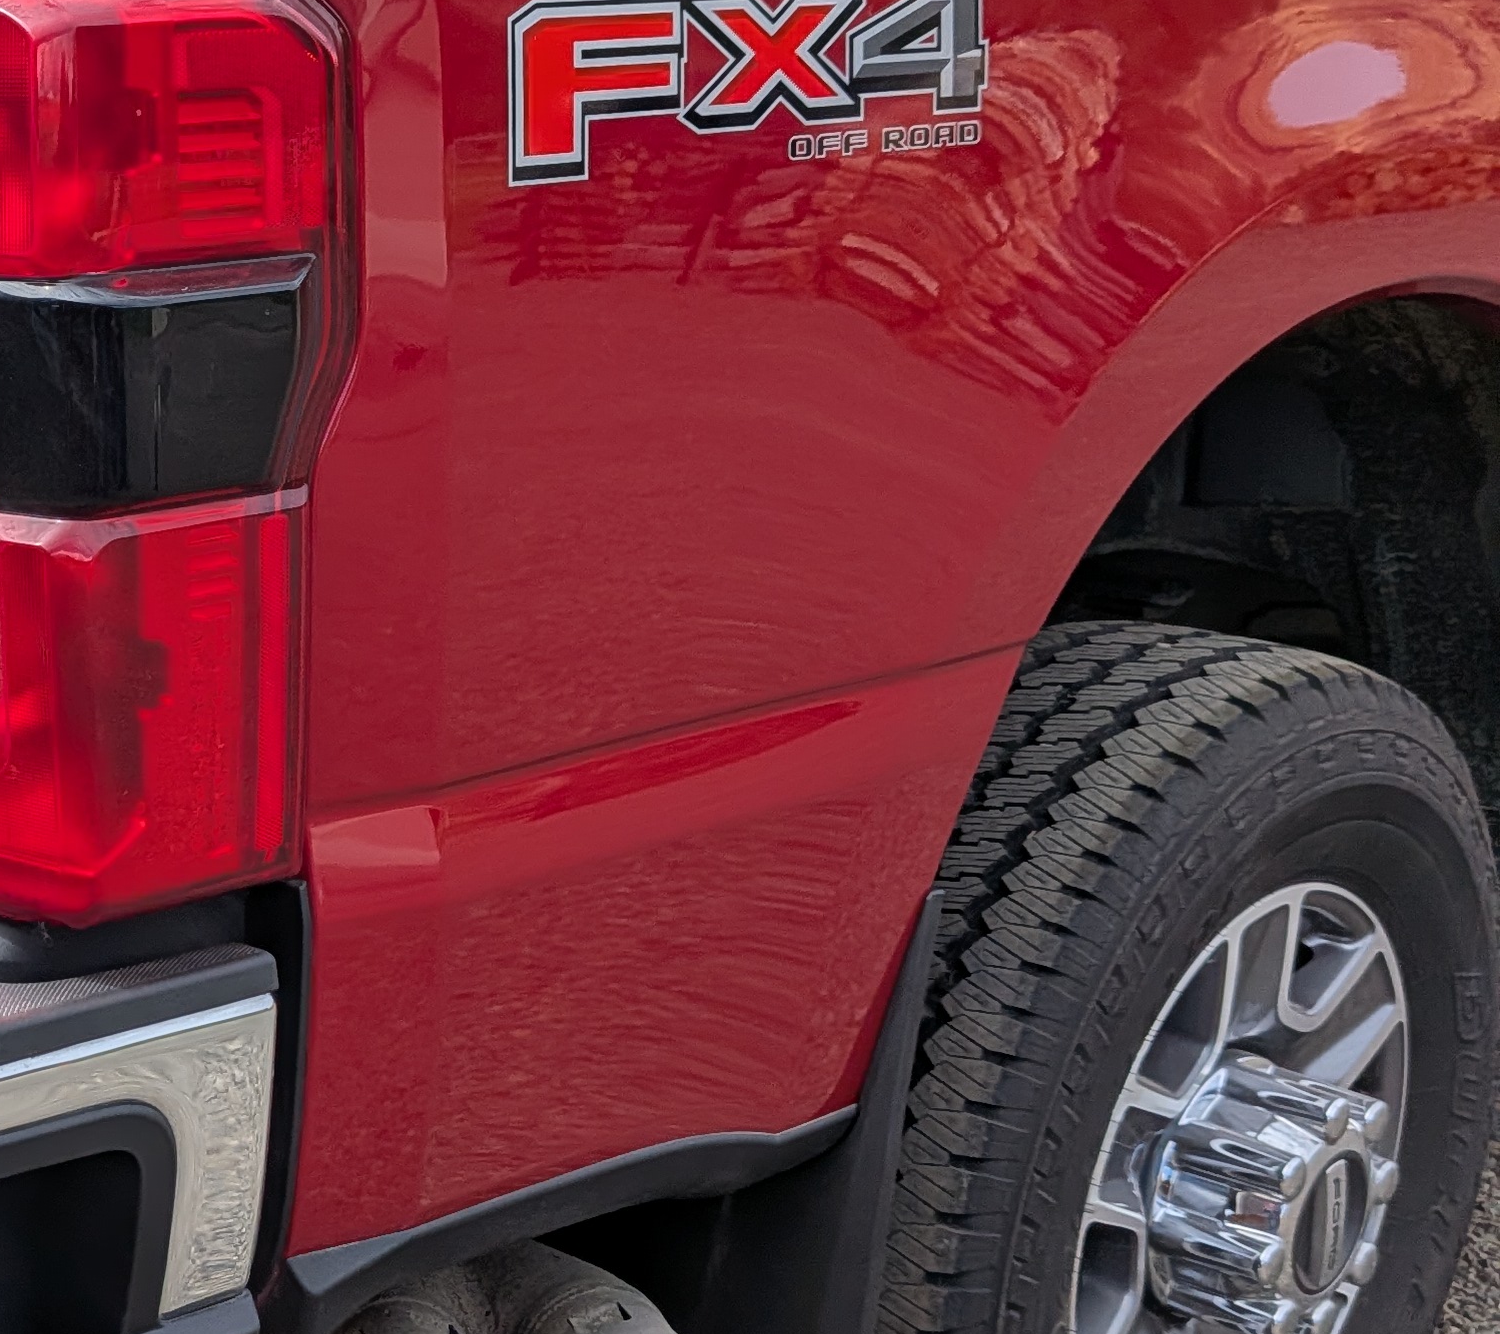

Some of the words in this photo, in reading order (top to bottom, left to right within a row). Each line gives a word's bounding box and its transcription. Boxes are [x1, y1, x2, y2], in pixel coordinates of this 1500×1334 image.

[788, 129, 869, 161] OFF
[881, 121, 980, 153] ROAD
[1327, 1176, 1342, 1270] FORD
